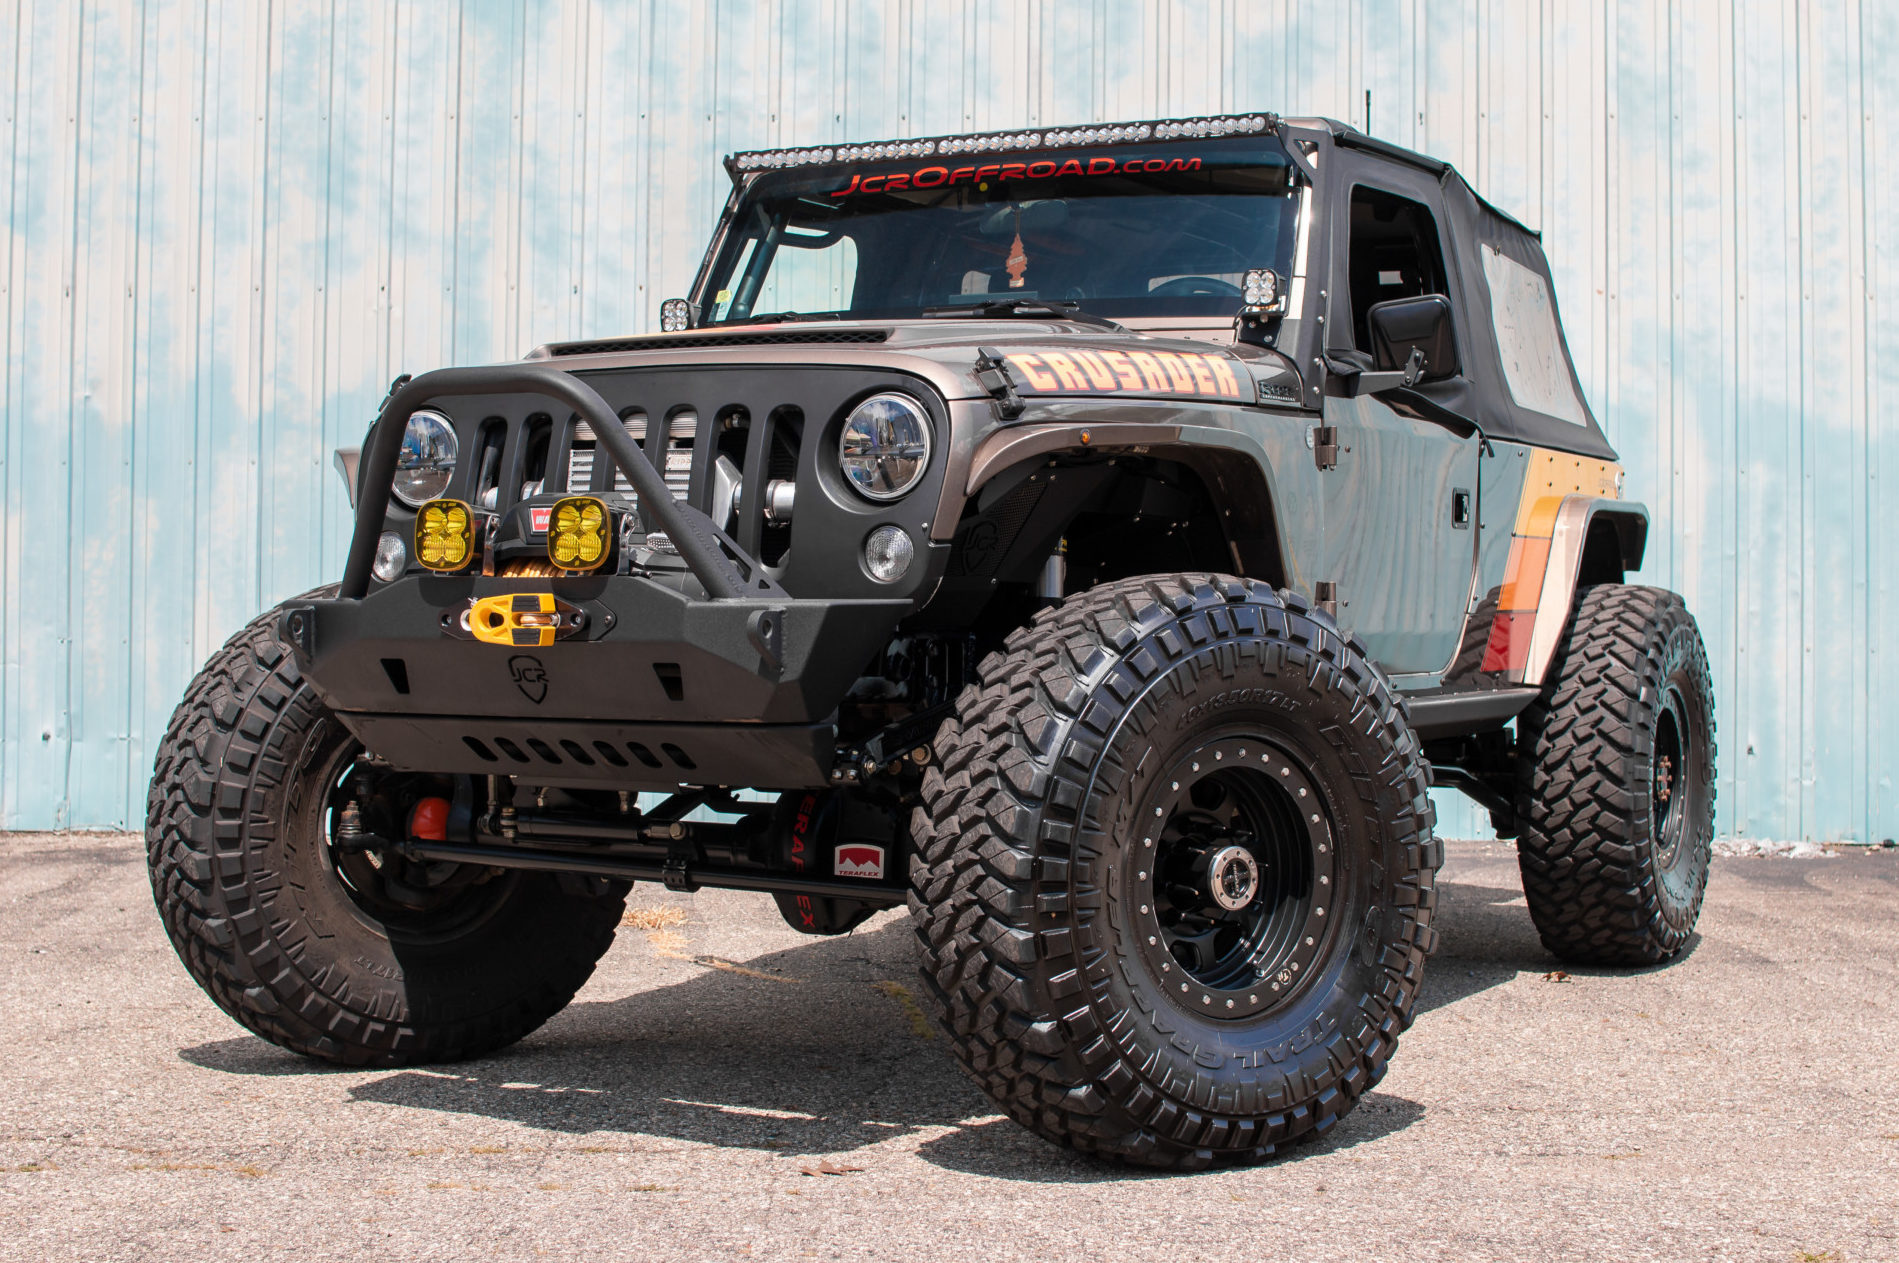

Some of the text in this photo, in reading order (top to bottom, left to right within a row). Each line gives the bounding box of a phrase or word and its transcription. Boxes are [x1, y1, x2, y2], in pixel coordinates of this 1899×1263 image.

[1006, 350, 1240, 398] CRUSADER
[536, 515, 549, 524] WA
[513, 667, 550, 683] JCR
